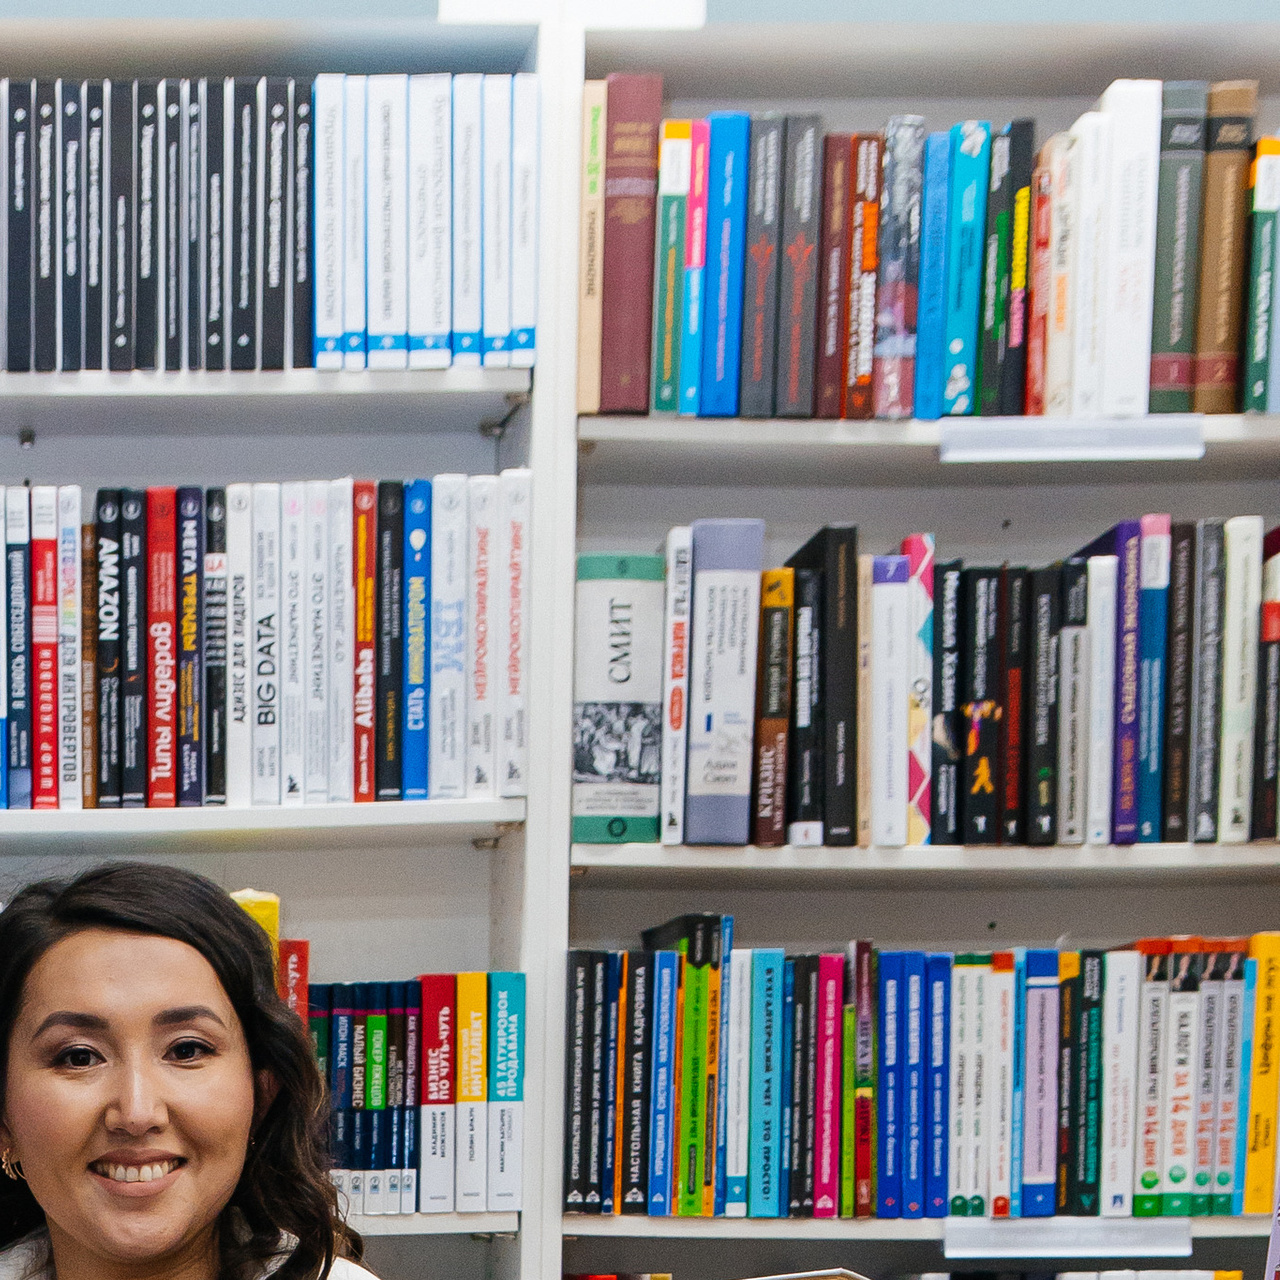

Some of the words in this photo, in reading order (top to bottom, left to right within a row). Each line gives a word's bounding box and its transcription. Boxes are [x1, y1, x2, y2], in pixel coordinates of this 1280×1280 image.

[98, 537, 118, 640] AMAZON
[181, 520, 198, 650] МЕГАТРЕНДЫ
[258, 614, 275, 676] DATA
[609, 598, 633, 684] СМИТ
[258, 684, 275, 725] BIG
[355, 649, 373, 728] Alibaba
[634, 966, 646, 1044] КАДРОВИКА
[633, 1051, 643, 1092] КНИГА
[630, 1100, 642, 1182] НАСТОЛЬНАЯ
